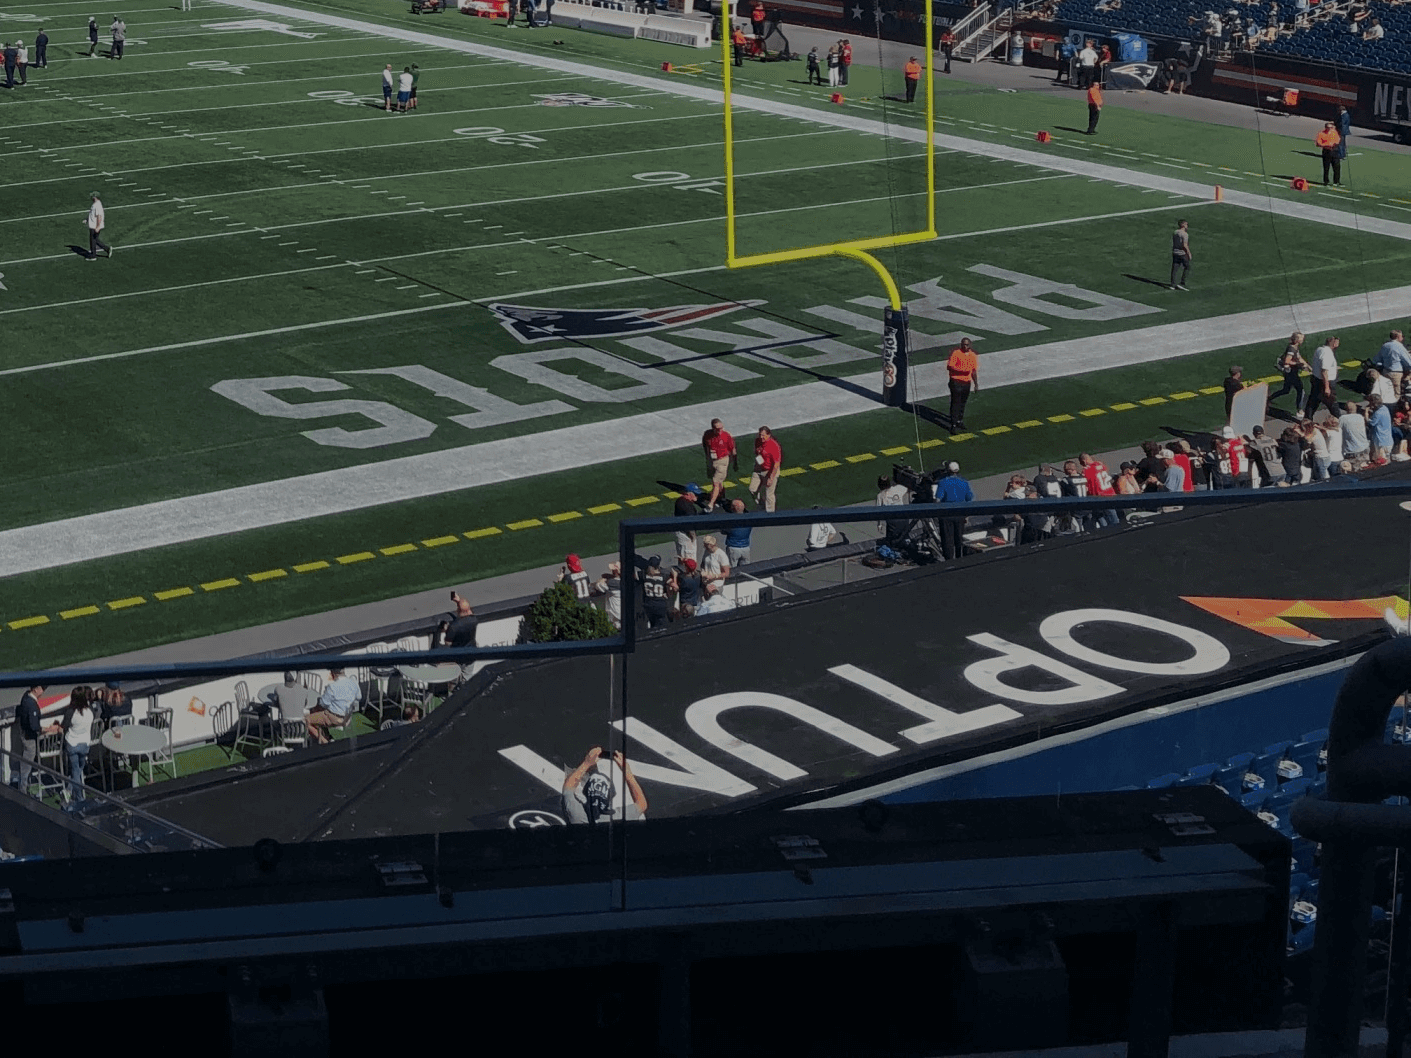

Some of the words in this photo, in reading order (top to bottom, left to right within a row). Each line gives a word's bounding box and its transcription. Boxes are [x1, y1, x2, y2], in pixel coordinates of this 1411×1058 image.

[1373, 81, 1411, 119] NE
[209, 262, 1167, 449] PATRIOTS
[497, 607, 1231, 799] OPTUM
